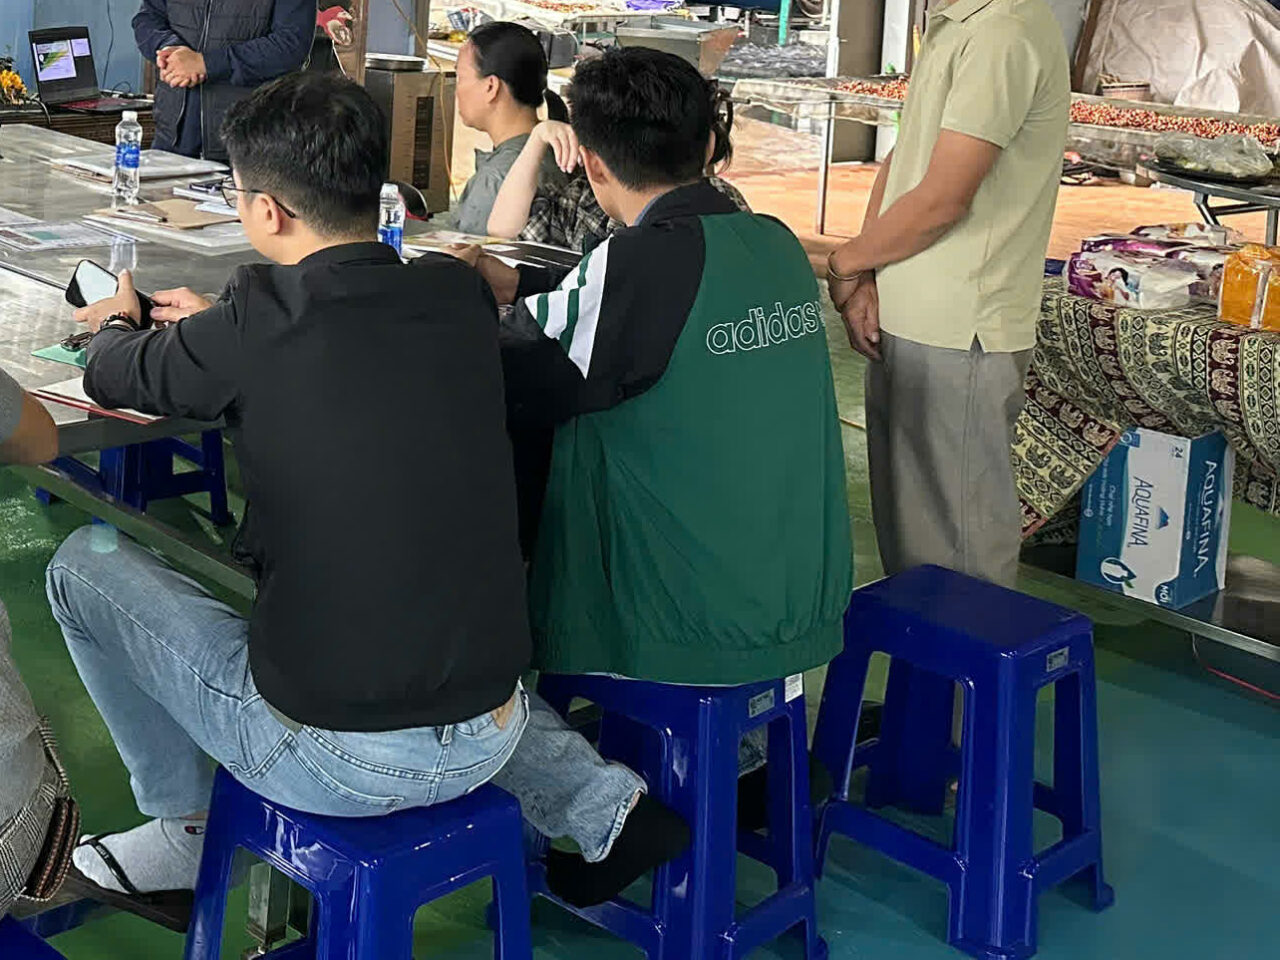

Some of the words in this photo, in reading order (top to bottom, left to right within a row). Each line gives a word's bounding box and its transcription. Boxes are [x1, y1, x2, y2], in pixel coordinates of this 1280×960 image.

[706, 301, 819, 355] adidas
[1174, 446, 1183, 458] 24
[1128, 476, 1154, 547] AQUAFINA
[1194, 460, 1217, 573] AQUAFINA
